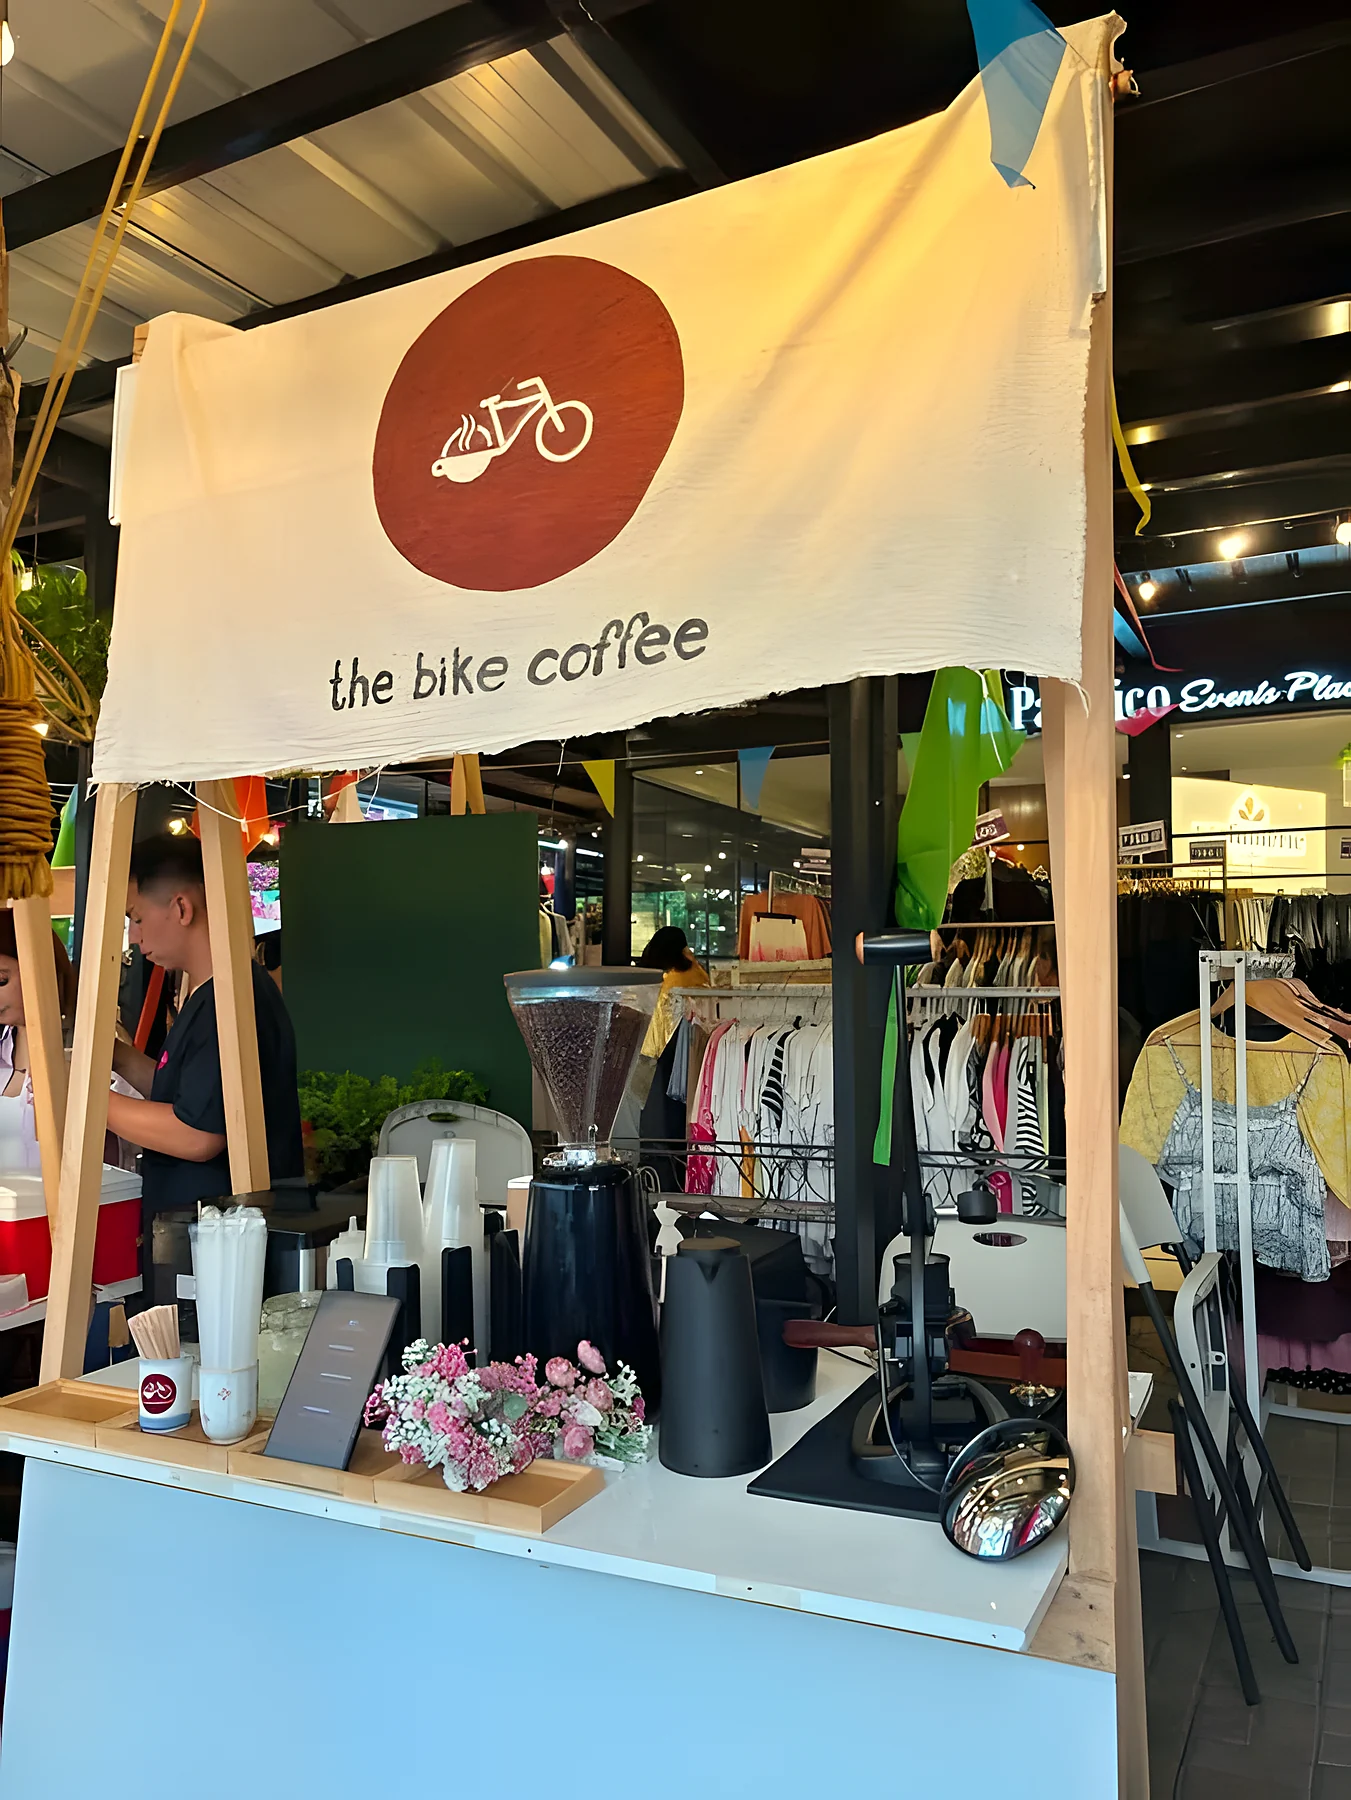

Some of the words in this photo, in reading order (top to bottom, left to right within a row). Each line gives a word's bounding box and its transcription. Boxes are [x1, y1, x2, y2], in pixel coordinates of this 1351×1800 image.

[329, 657, 394, 711] the
[413, 647, 509, 700] bike
[527, 611, 709, 686] coffee
